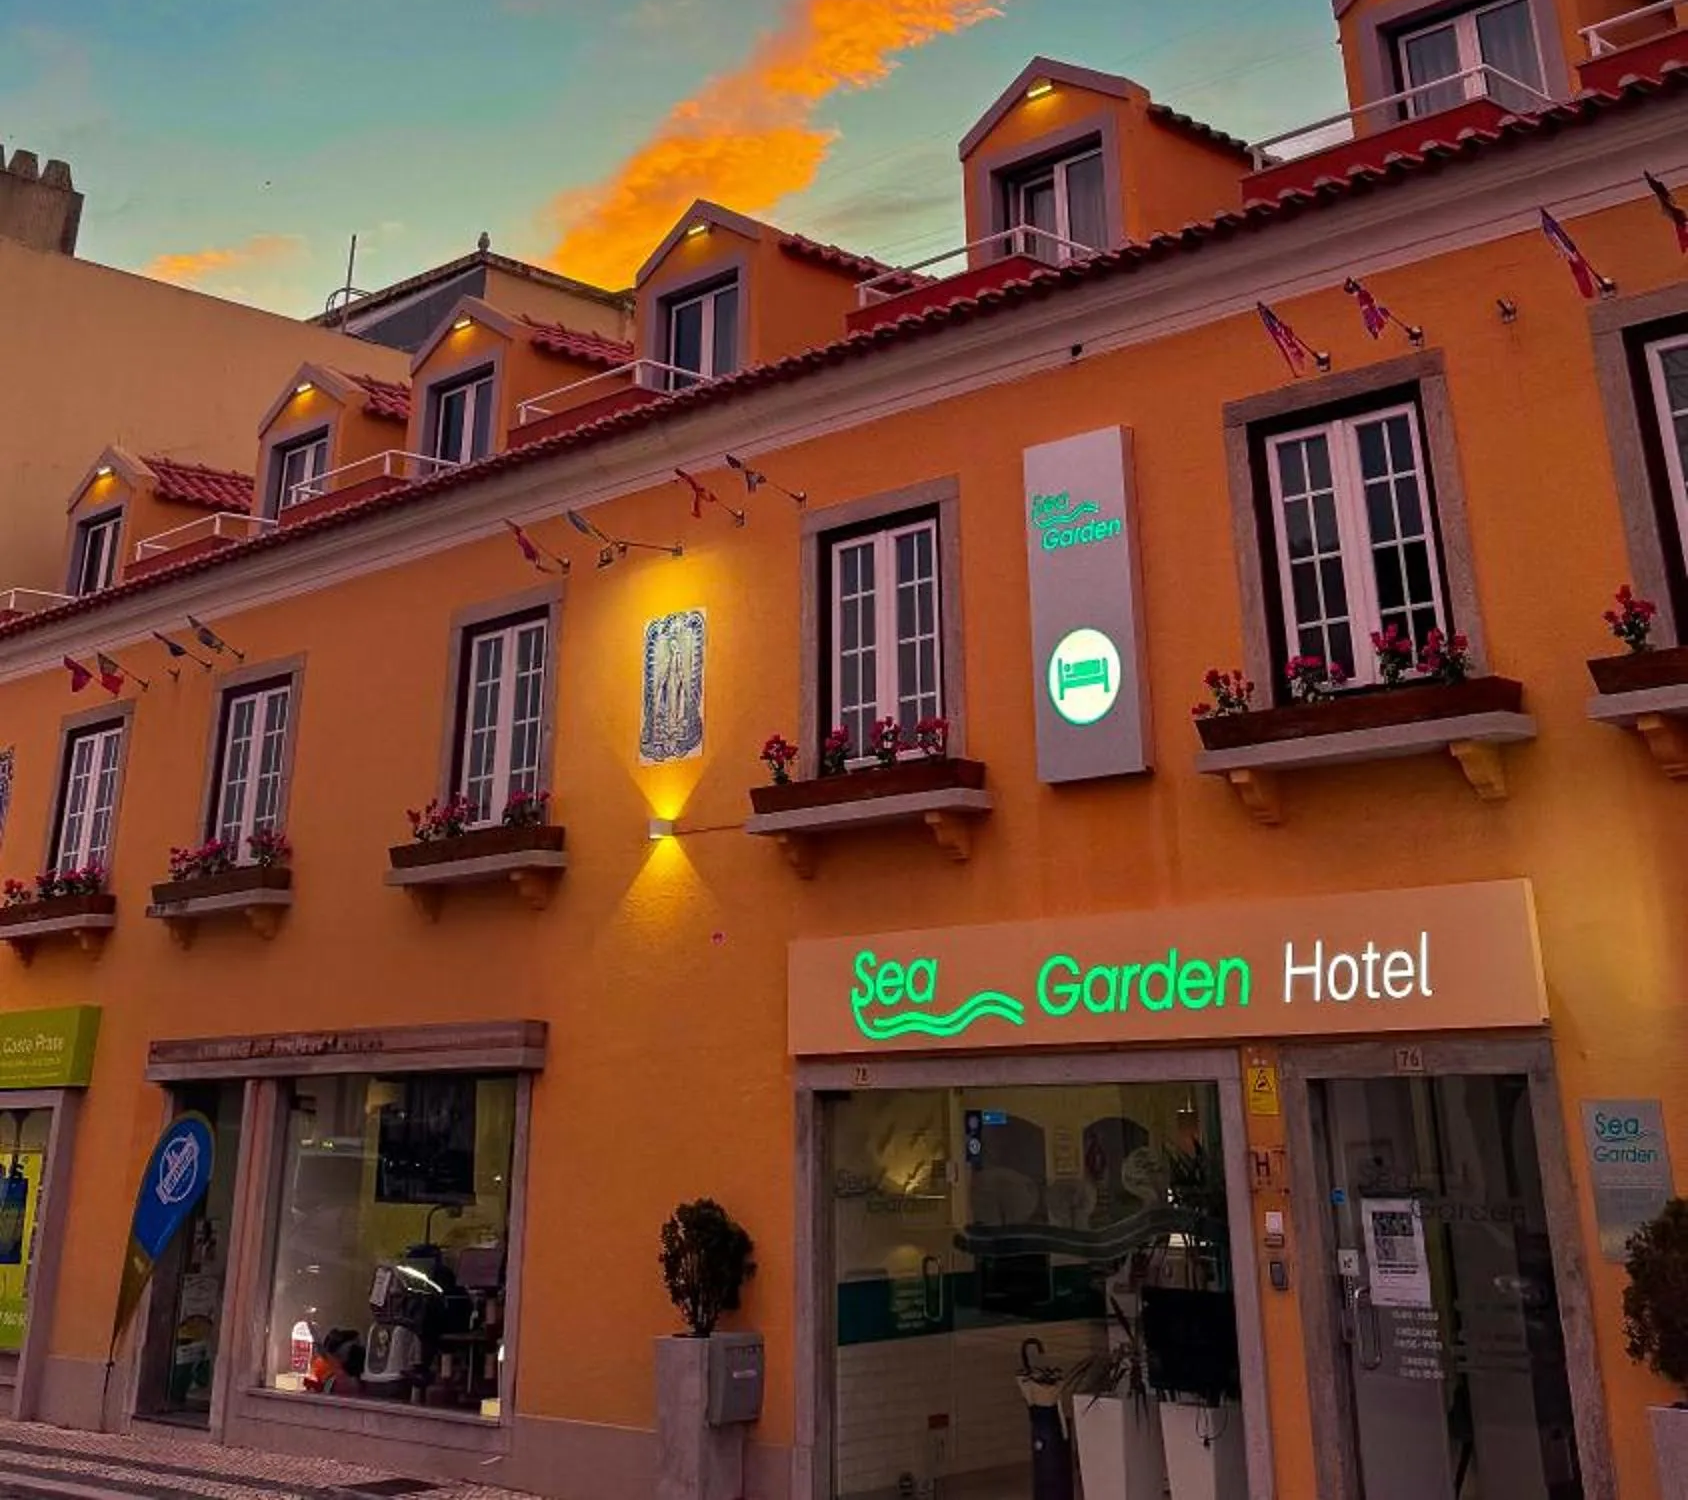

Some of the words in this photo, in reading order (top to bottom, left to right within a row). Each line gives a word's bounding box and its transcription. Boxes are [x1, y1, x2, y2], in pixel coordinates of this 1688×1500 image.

[1031, 492, 1069, 517] Sea
[1042, 518, 1121, 550] Garden
[851, 950, 938, 1007] Sea
[1037, 948, 1250, 1016] Garden
[1283, 930, 1433, 1004] Hotel
[1399, 1048, 1419, 1067] 76
[1595, 1111, 1640, 1135] Sea
[1594, 1146, 1658, 1164] Garden
